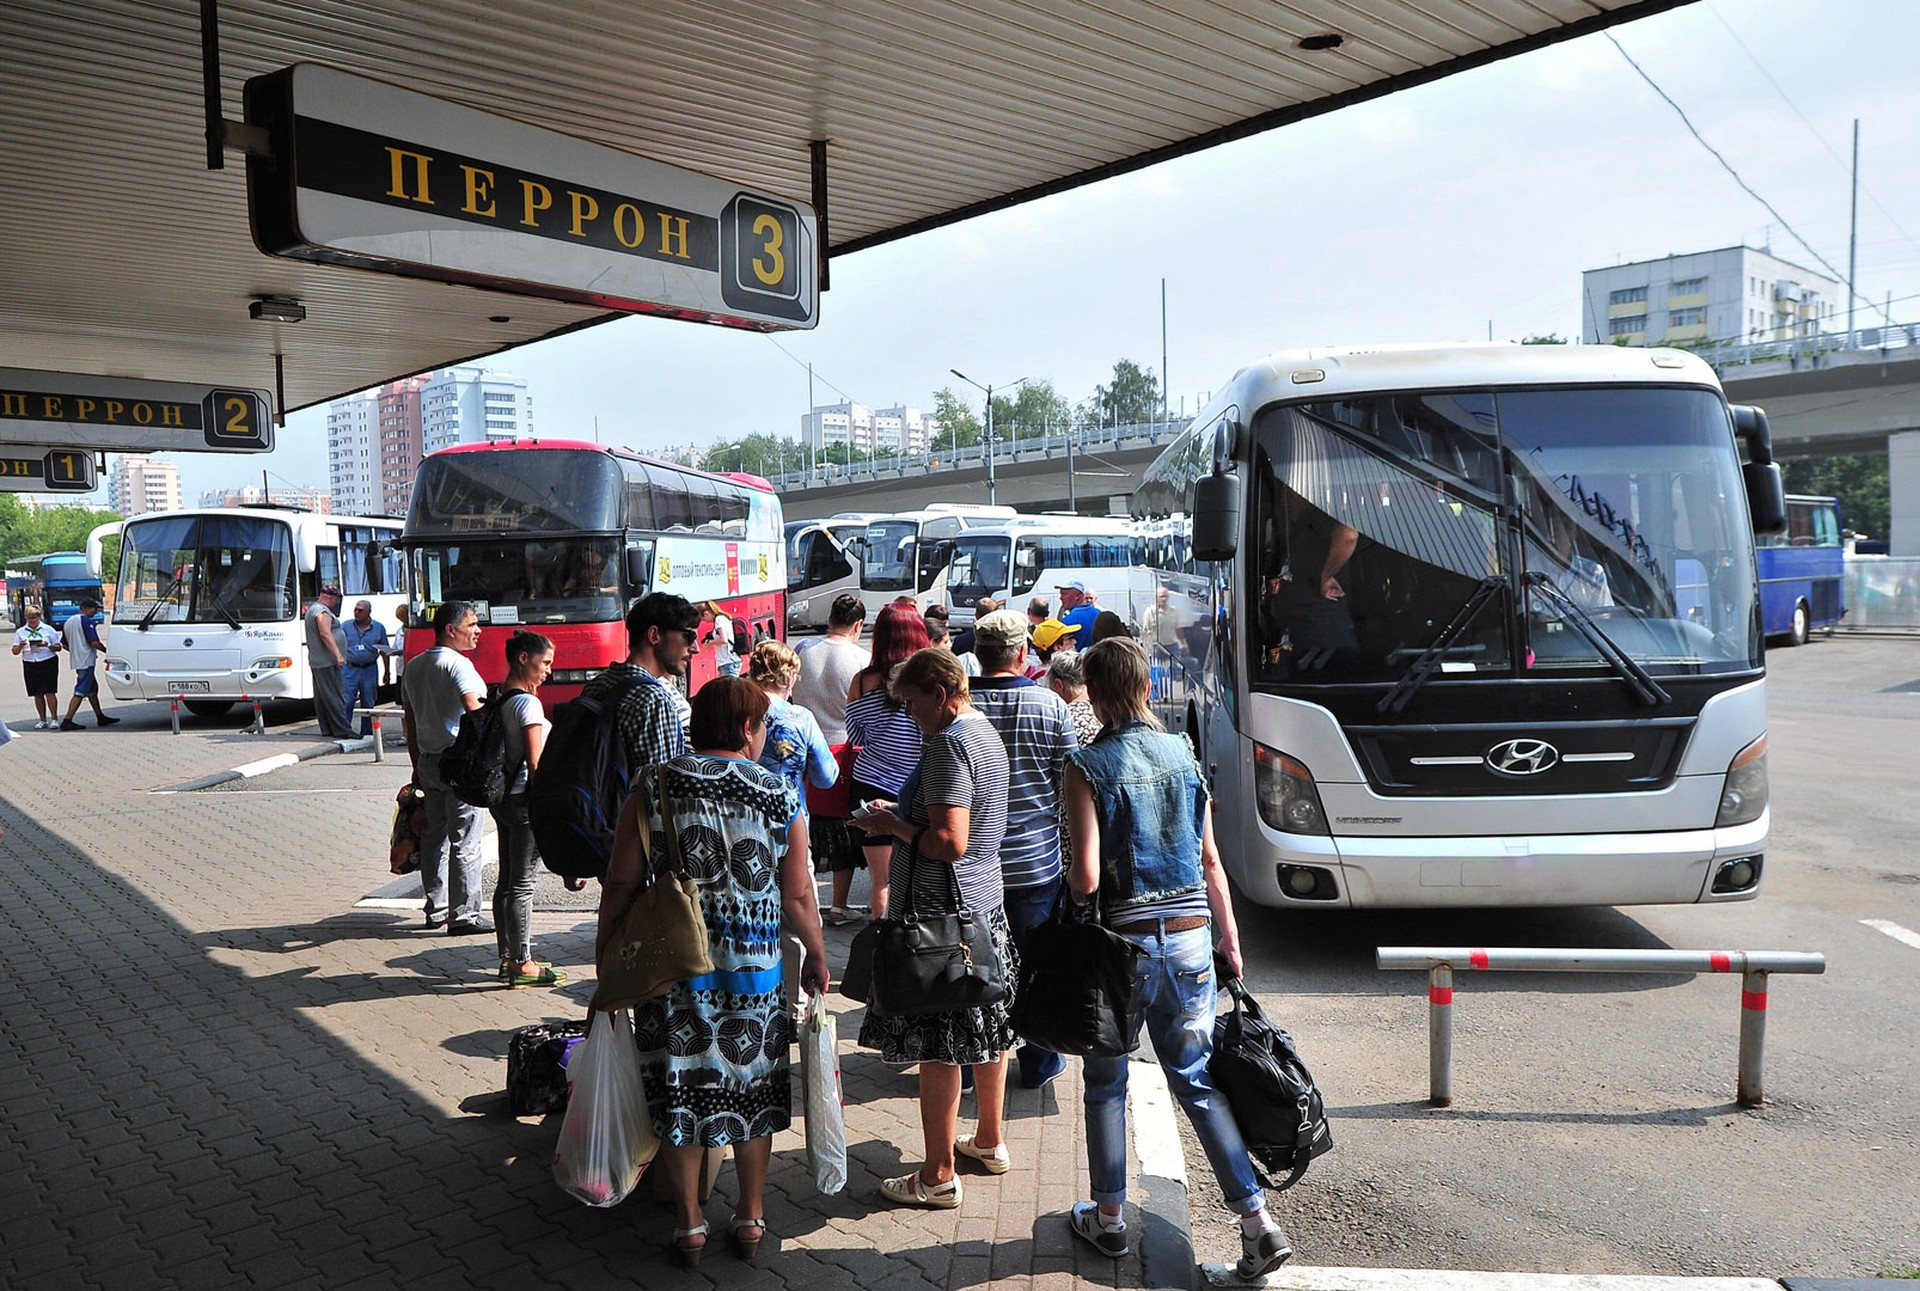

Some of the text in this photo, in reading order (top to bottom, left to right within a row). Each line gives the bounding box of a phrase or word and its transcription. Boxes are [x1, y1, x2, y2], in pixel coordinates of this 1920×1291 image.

[384, 145, 785, 286] ПЕРРОН 3
[1, 393, 249, 433] ПЕРРОН 2
[60, 455, 74, 479] 1
